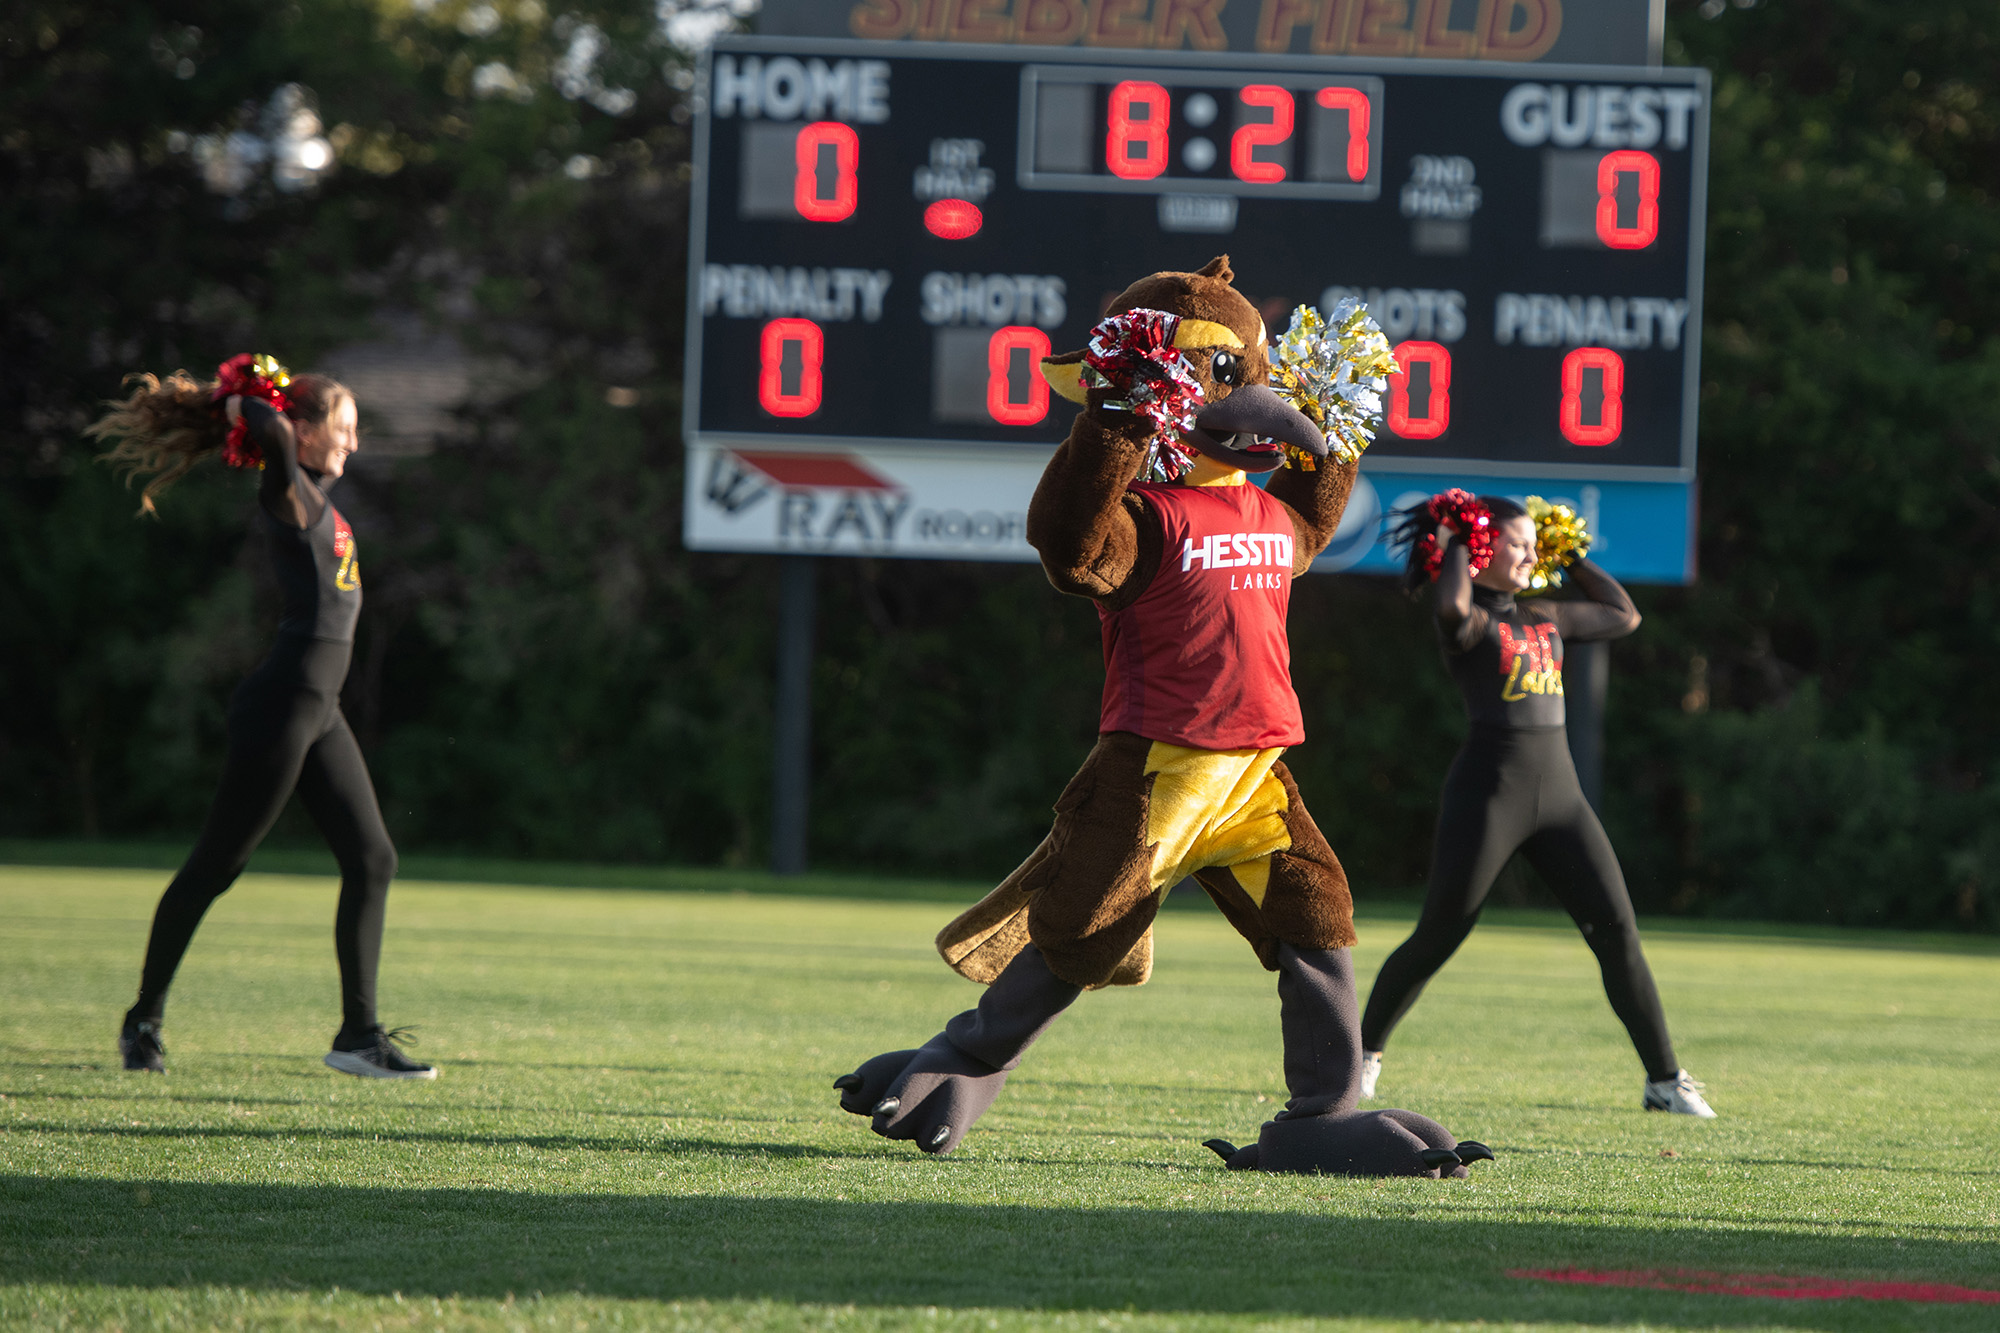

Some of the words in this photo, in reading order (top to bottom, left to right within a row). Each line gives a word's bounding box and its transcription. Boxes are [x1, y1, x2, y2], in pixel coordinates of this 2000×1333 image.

[711, 55, 891, 124] HOME
[1501, 83, 1698, 150] GUEST
[794, 121, 859, 223] 0
[1596, 150, 1660, 250] 0
[704, 264, 892, 322] PENALTY
[921, 270, 1067, 327] SHOTS
[1495, 293, 1688, 350] PENALTY
[759, 318, 824, 418] 0
[987, 326, 1052, 426] 0
[1387, 340, 1452, 440] 0
[1560, 347, 1624, 447] 0
[913, 508, 1028, 545] ROOF
[1230, 572, 1281, 590] LARKS
